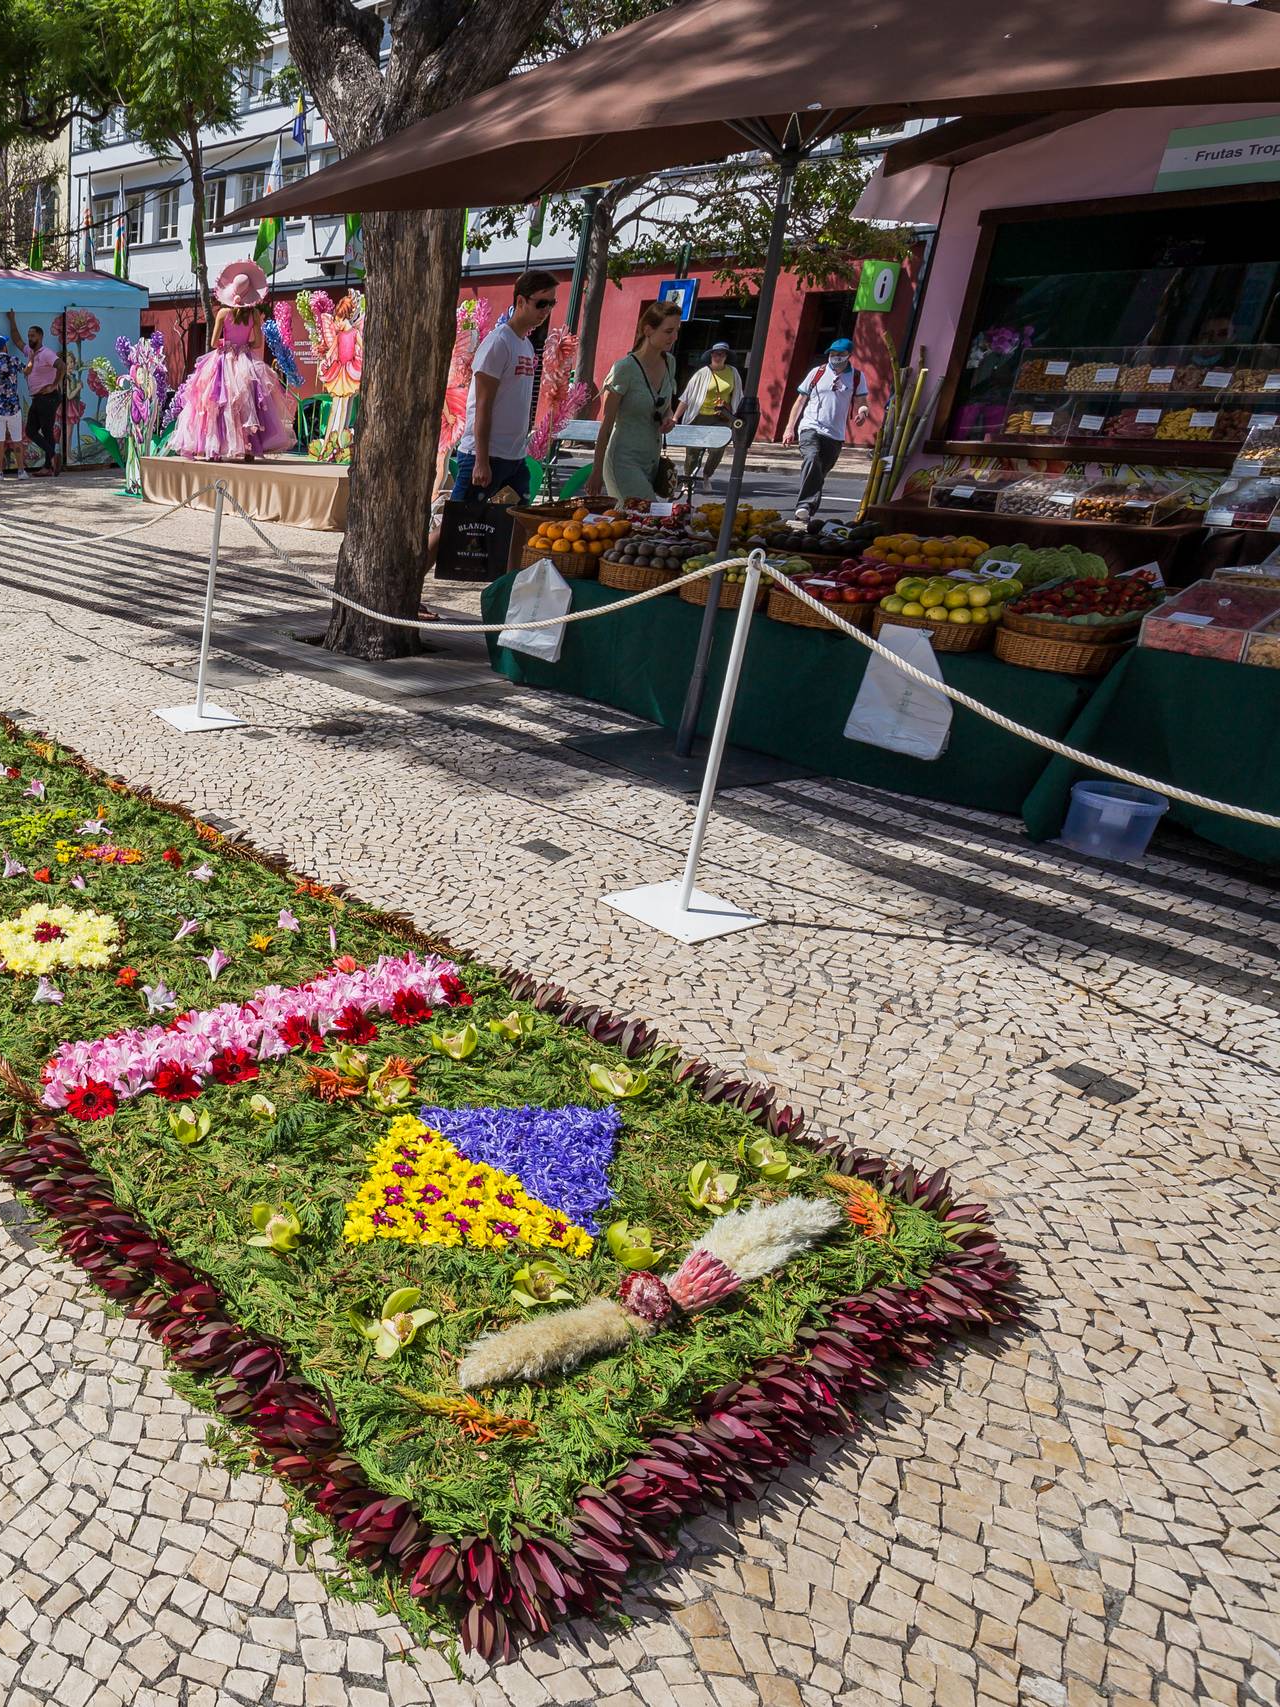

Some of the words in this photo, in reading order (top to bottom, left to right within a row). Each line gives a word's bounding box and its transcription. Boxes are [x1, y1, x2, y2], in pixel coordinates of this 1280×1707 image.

[1194, 148, 1244, 162] Frutas
[1248, 143, 1280, 156] Trop
[458, 522, 496, 534] BLANDY'S
